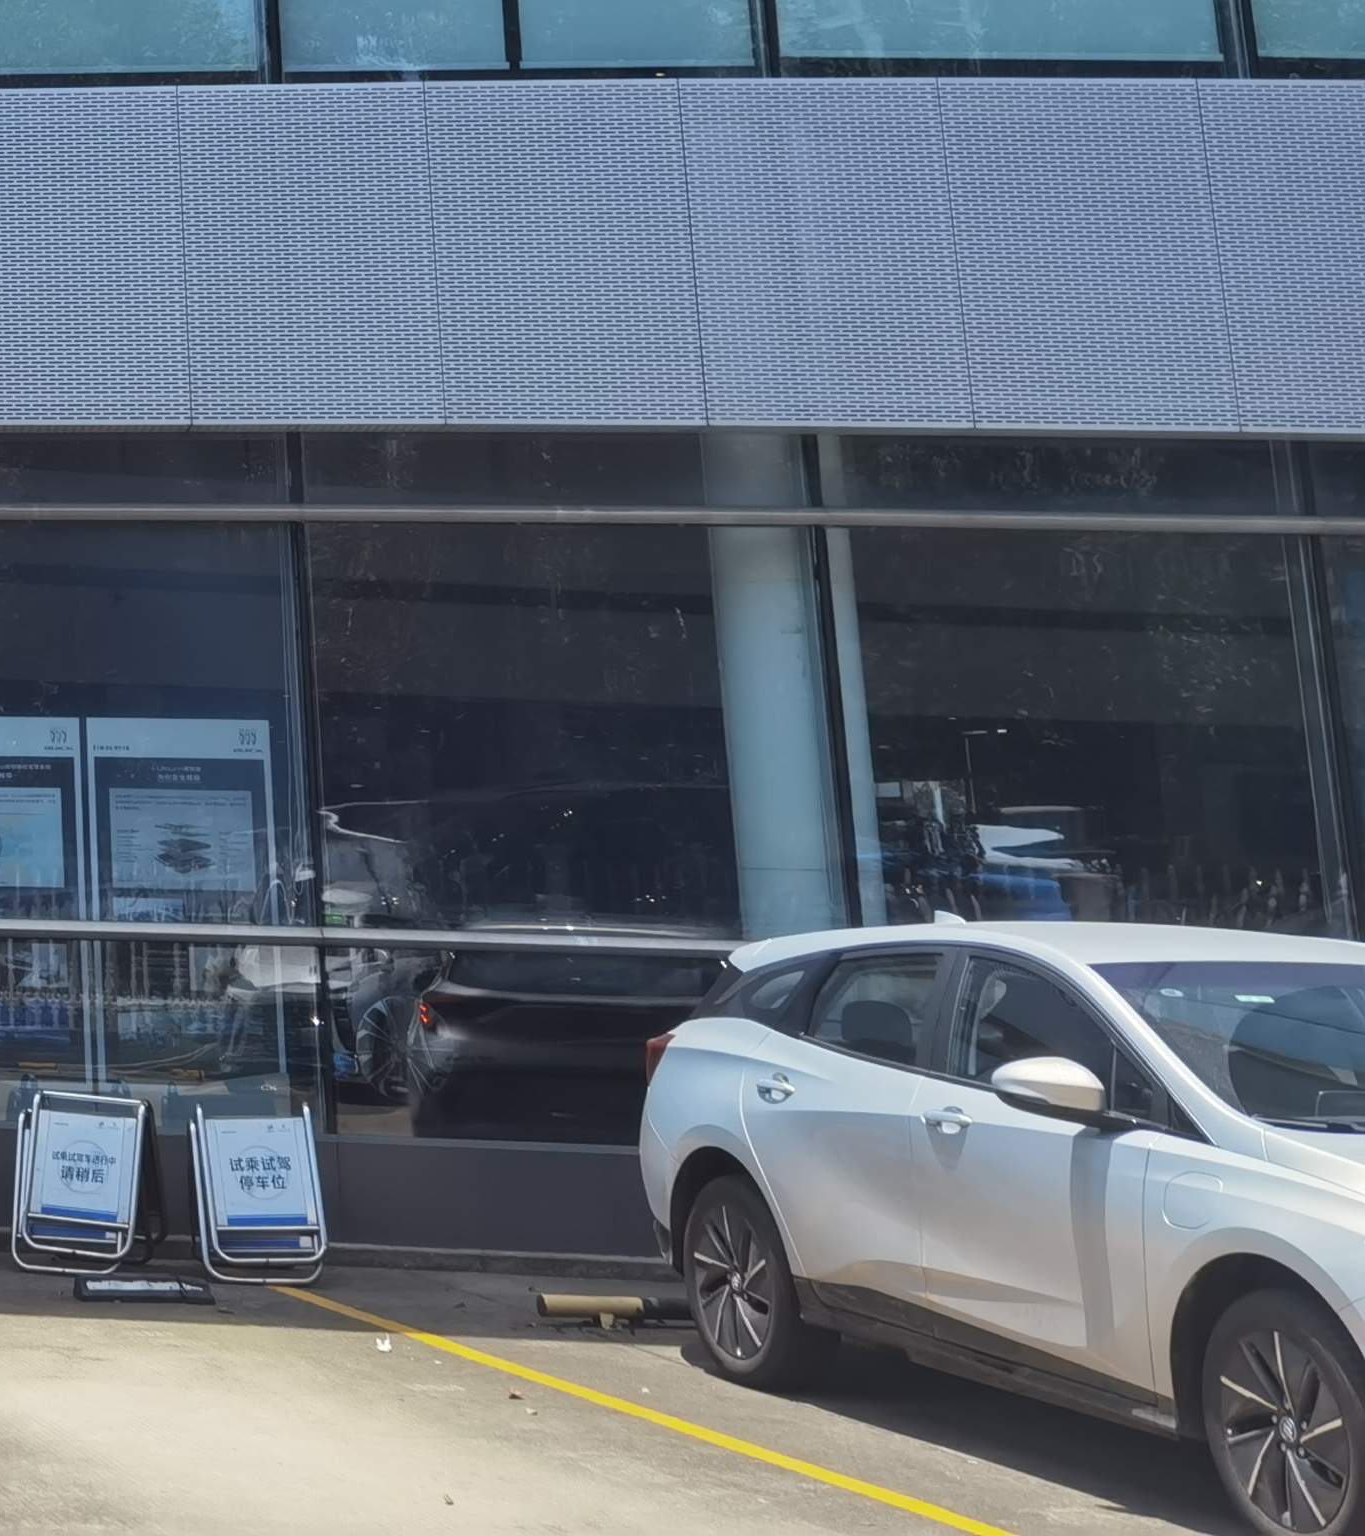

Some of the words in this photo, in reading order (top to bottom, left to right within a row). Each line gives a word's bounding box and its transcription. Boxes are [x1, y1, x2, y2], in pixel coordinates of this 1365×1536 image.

[229, 1155, 292, 1172] 试乘试驾
[60, 1165, 105, 1184] 请稍后
[239, 1175, 287, 1191] 停车位
